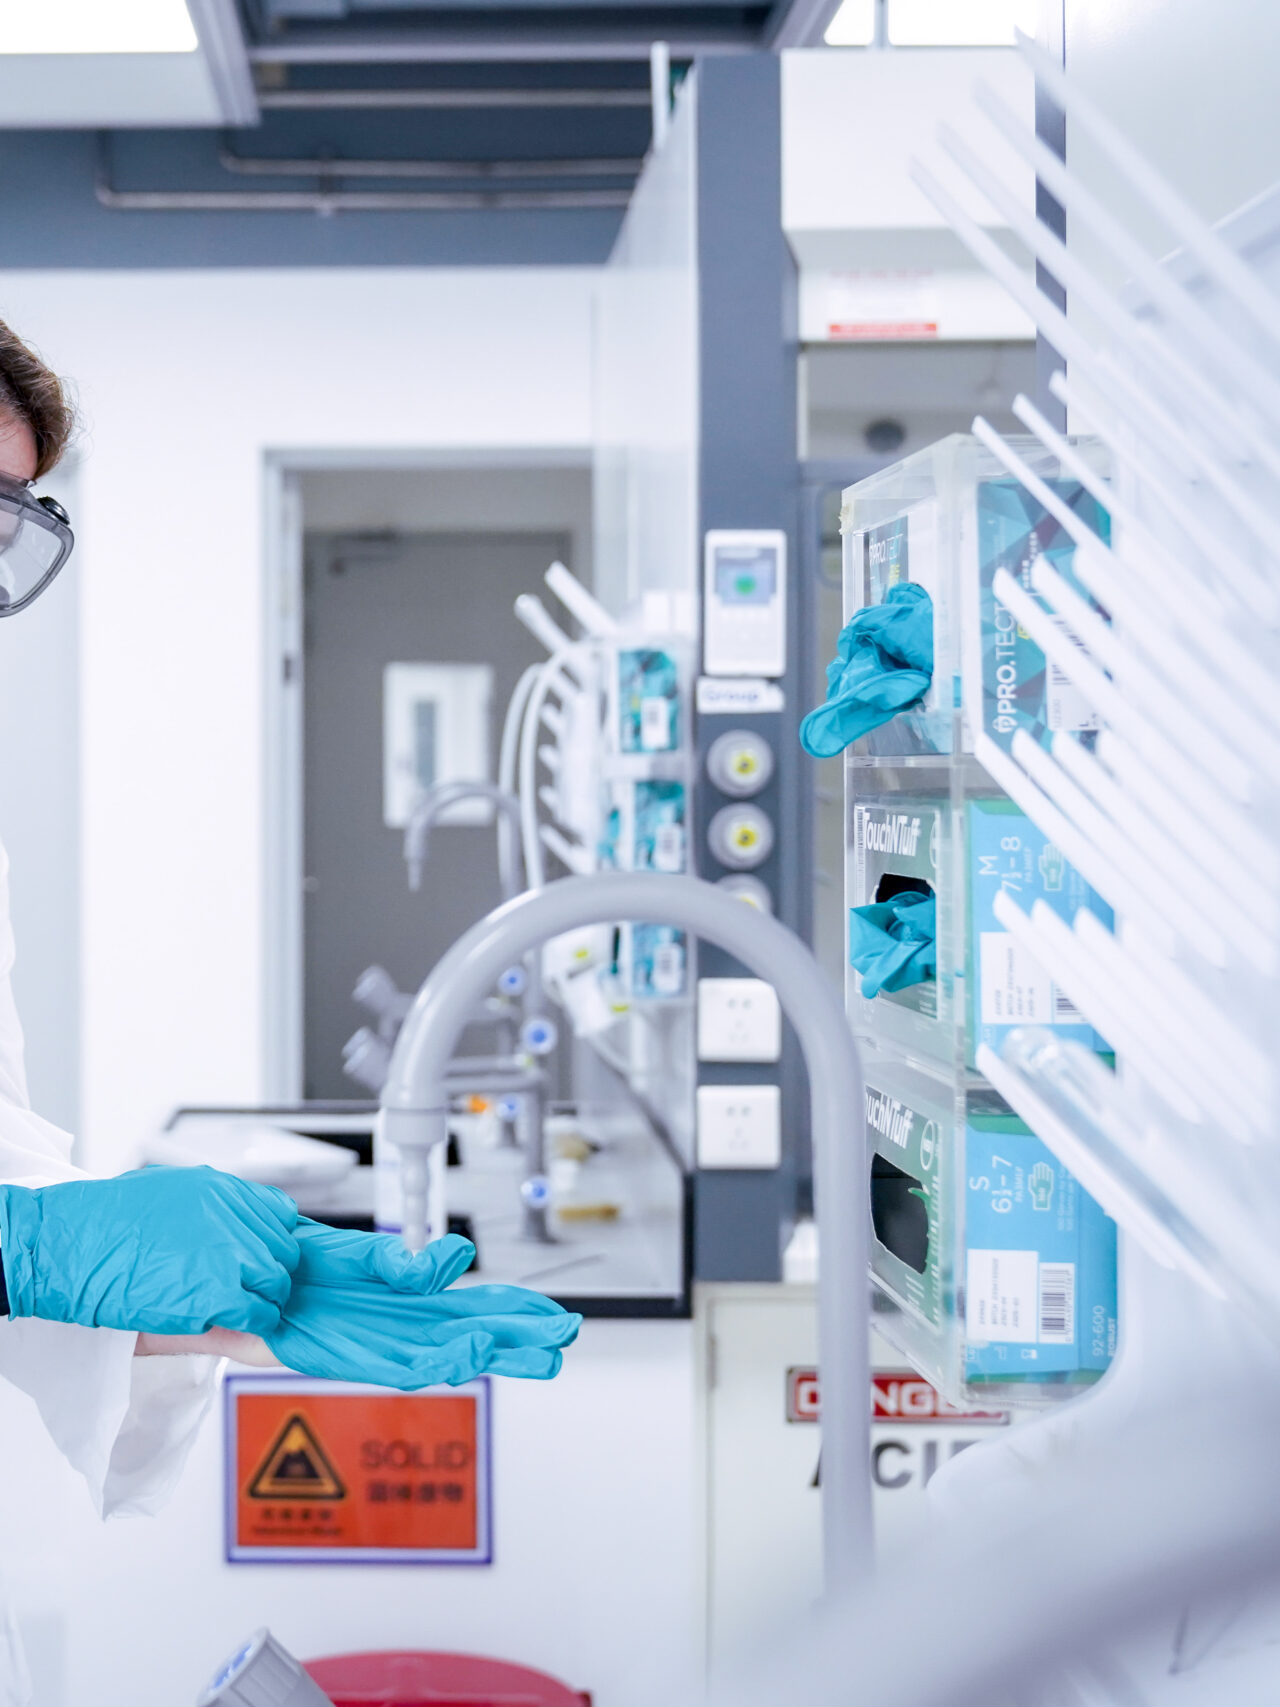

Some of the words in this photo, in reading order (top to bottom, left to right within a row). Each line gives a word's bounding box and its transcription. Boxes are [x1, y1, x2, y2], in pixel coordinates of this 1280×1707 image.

[977, 855, 999, 876] M
[865, 1091, 914, 1150] uchNTuff
[968, 1175, 990, 1192] S
[360, 1440, 469, 1470] SOLID
